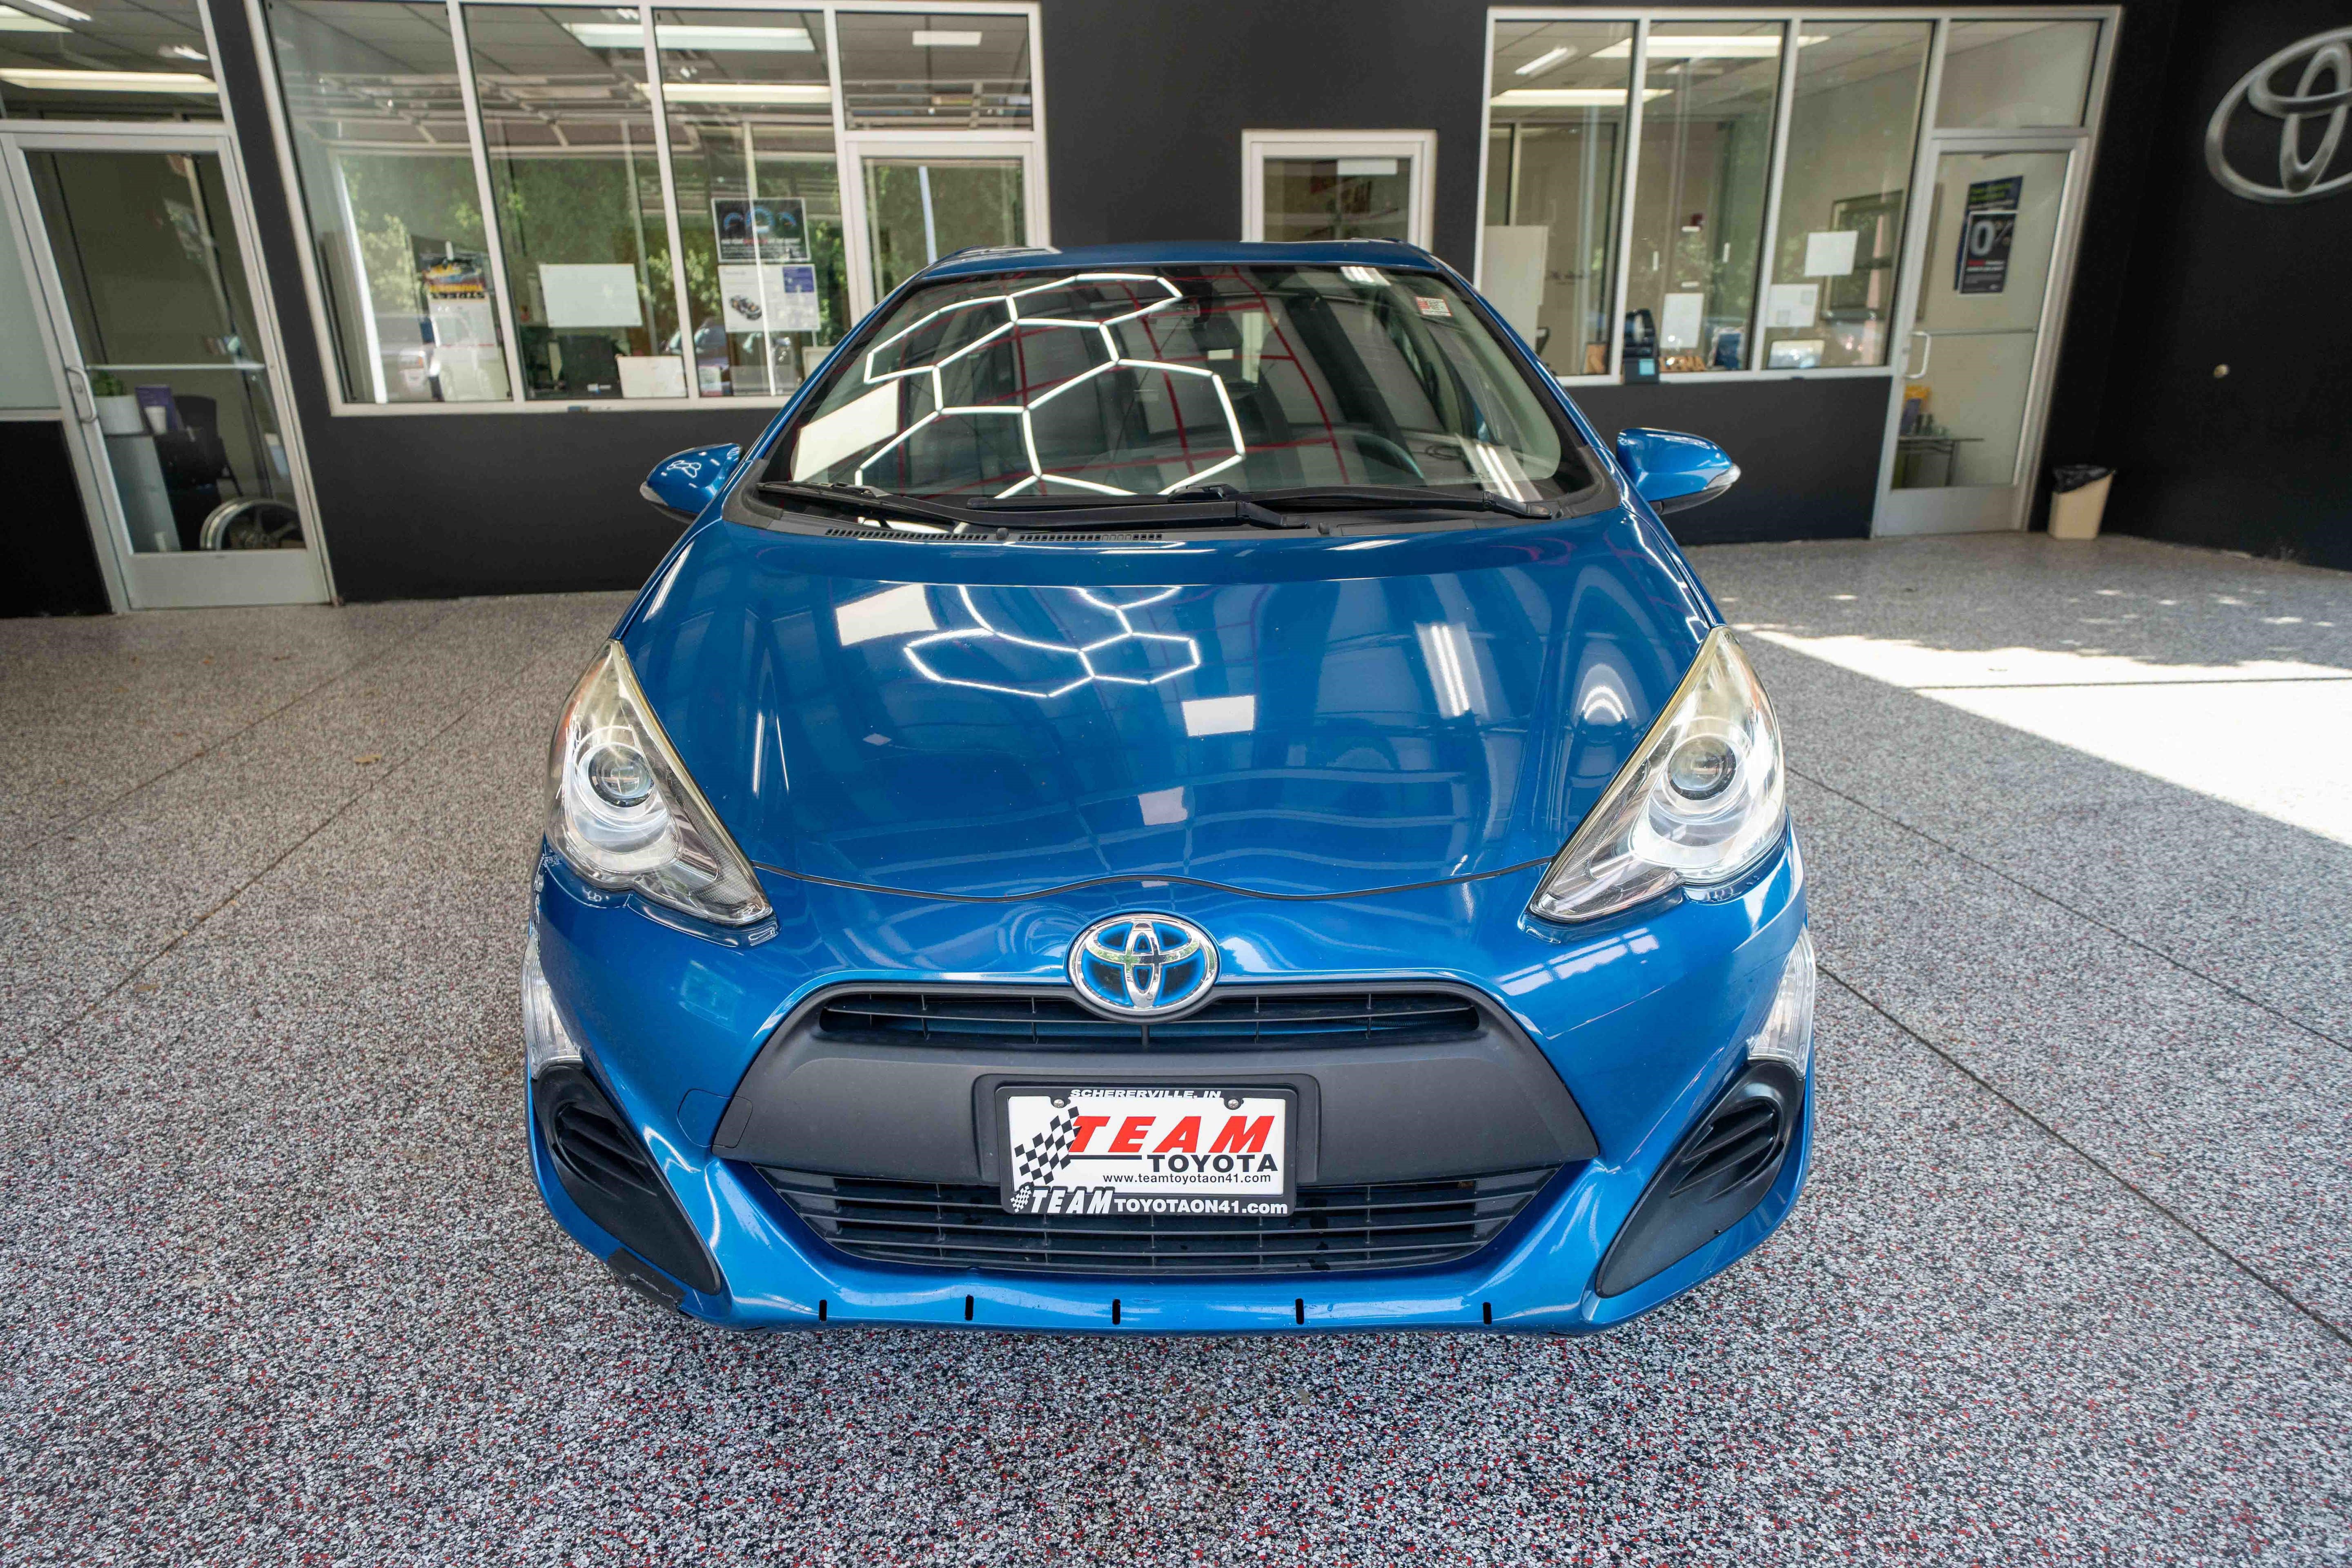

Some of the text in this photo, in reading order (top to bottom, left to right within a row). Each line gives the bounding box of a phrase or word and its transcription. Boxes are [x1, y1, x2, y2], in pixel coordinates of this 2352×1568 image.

[1969, 220, 2014, 256] 0%
[1068, 1116, 1275, 1153] TEAM
[1147, 1154, 1278, 1173] TOYOTA
[1103, 1173, 1271, 1185] www.teamtoyotaon41.com
[1031, 1189, 1288, 1214] TEAM TOYOTAON41.com
